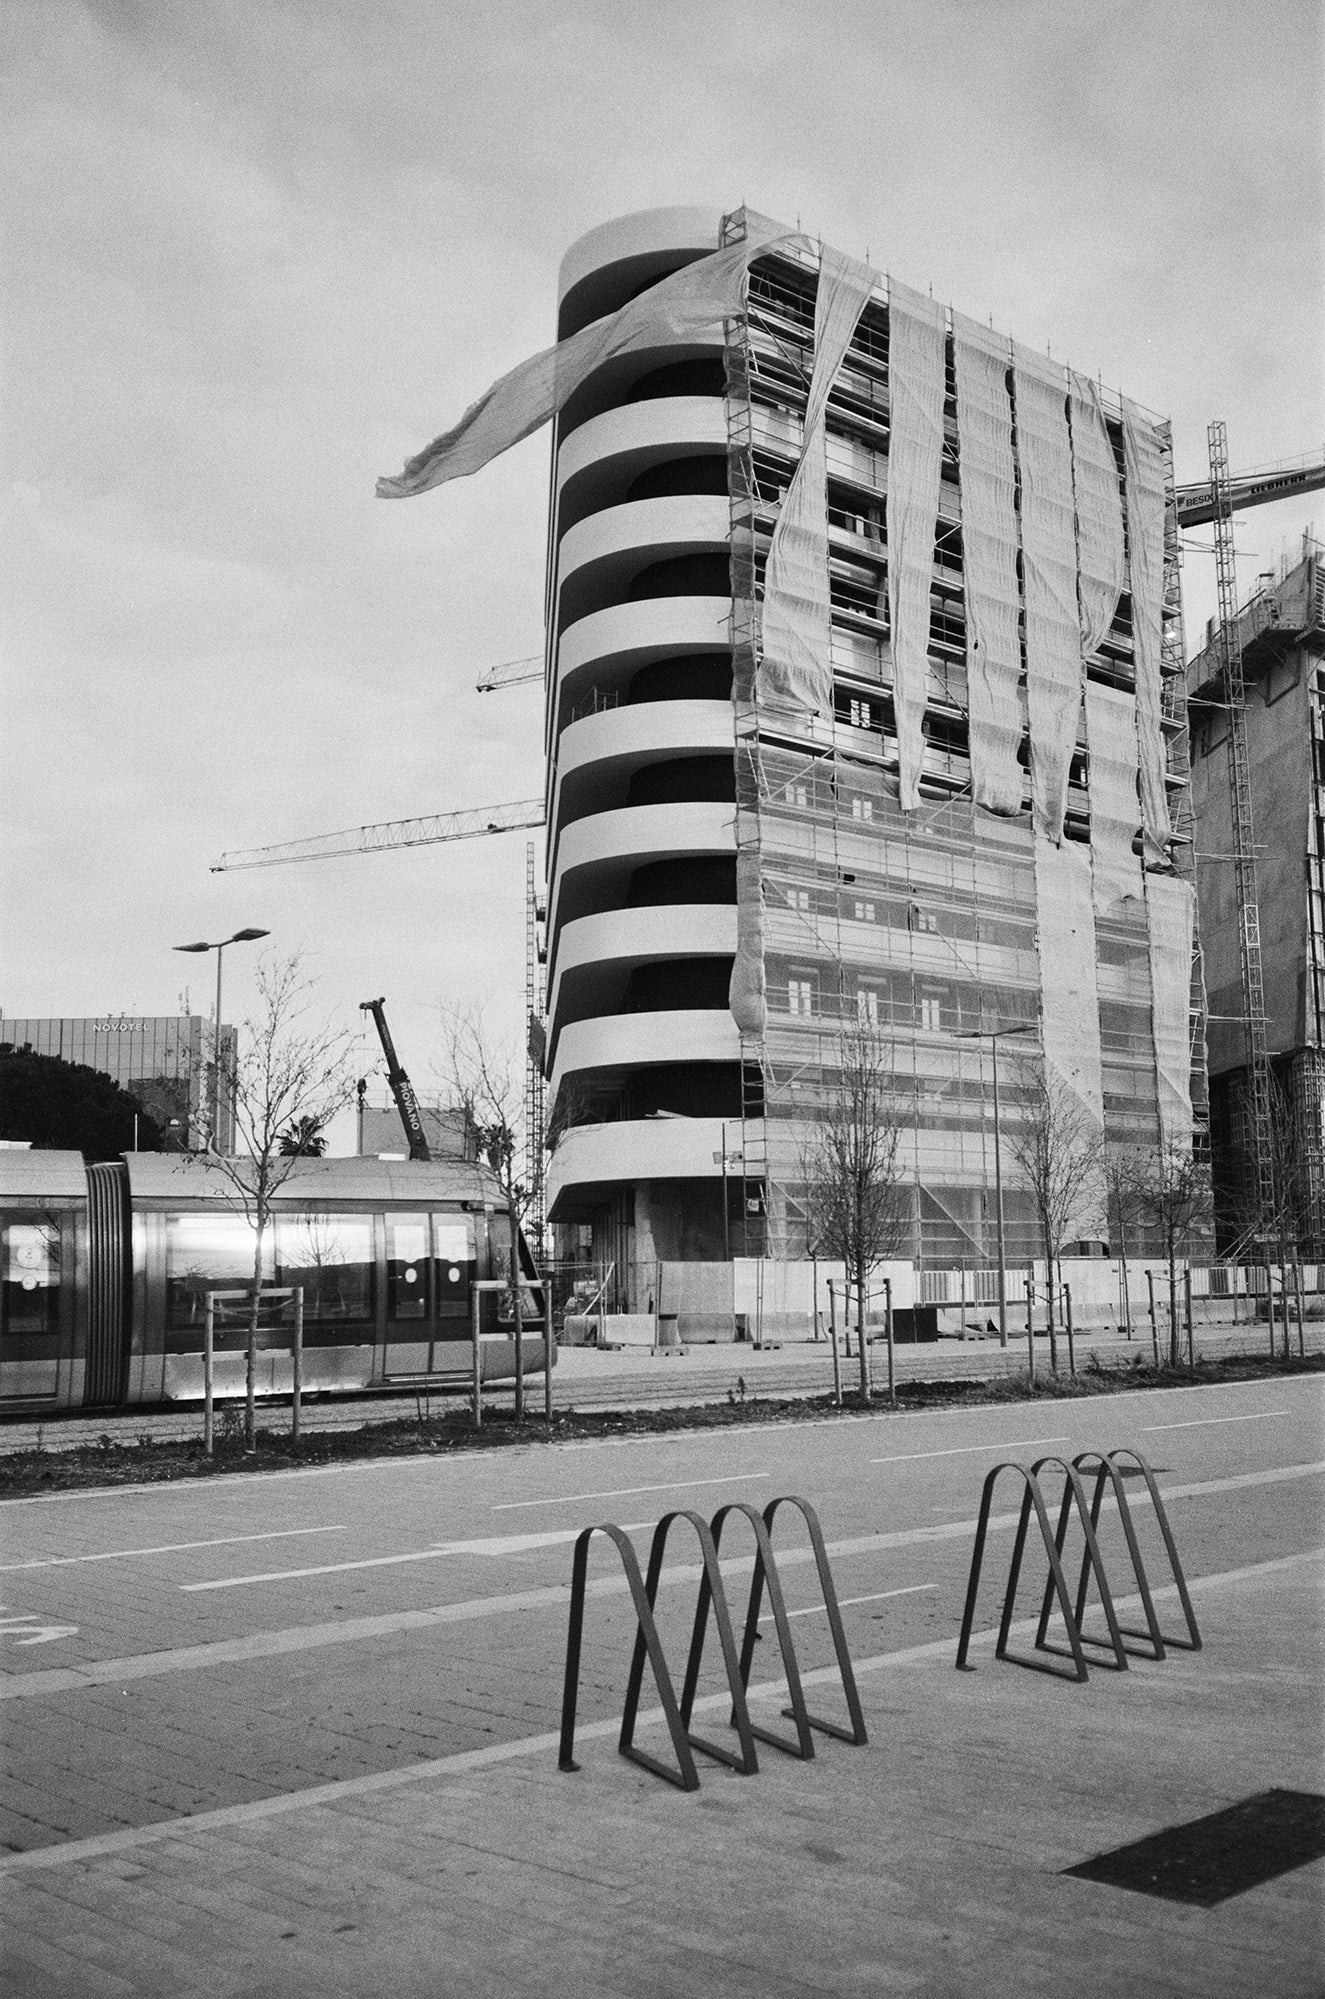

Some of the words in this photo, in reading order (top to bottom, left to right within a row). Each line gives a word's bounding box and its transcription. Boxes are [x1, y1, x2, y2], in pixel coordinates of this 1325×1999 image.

[1251, 474, 1306, 494] LIEBHERR
[1186, 493, 1213, 507] BESIX
[93, 1024, 149, 1032] NOVOTEL
[399, 1082, 420, 1130] PIOVANO
